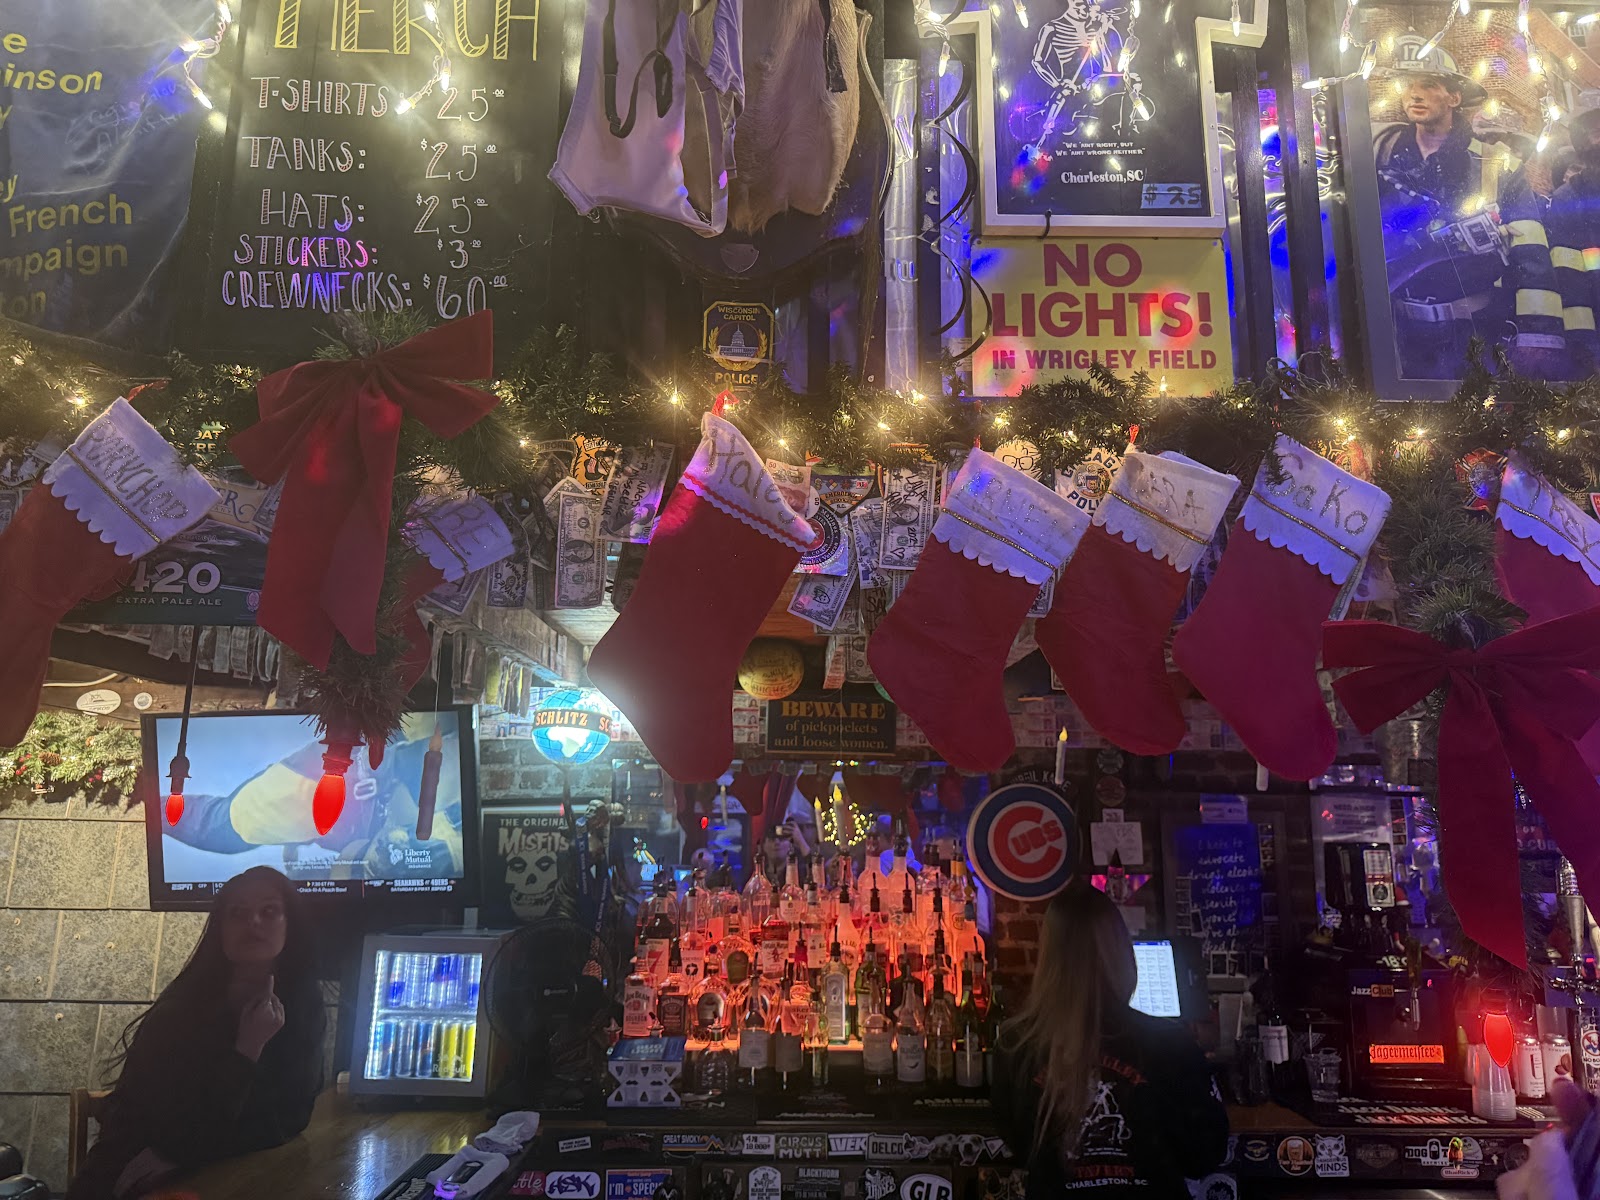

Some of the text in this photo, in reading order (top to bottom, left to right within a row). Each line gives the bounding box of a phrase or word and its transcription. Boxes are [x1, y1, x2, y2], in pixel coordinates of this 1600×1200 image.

[1403, 45, 1420, 61] 17
[0, 63, 103, 94] inson
[242, 136, 366, 172] TANKS:
[9, 193, 132, 238] French
[261, 189, 365, 232] HATS:
[234, 234, 378, 268] STICKERS:
[1043, 243, 1142, 287] NO
[222, 270, 412, 313] CREWNECKS:
[718, 305, 760, 315] WISCONSIN
[723, 313, 756, 321] CAPITOL
[991, 292, 1213, 338] LIGHTS!
[993, 350, 1217, 370] IN WRIGLEY FIELD
[715, 372, 759, 384] POLICE
[161, 597, 193, 605] PALE
[197, 598, 222, 606] ALE
[782, 701, 886, 719] BEWARE
[535, 711, 589, 726] SCHLITZ
[785, 720, 878, 735] of pickpockets
[775, 736, 798, 747] and
[803, 736, 837, 747] loose
[500, 818, 519, 826] THE
[405, 849, 431, 857] Liberty
[779, 1136, 823, 1147] CIRCUS
[779, 1149, 822, 1159] MUTT
[1407, 1148, 1428, 1158] DOG
[1316, 1163, 1348, 1171] MINDS
